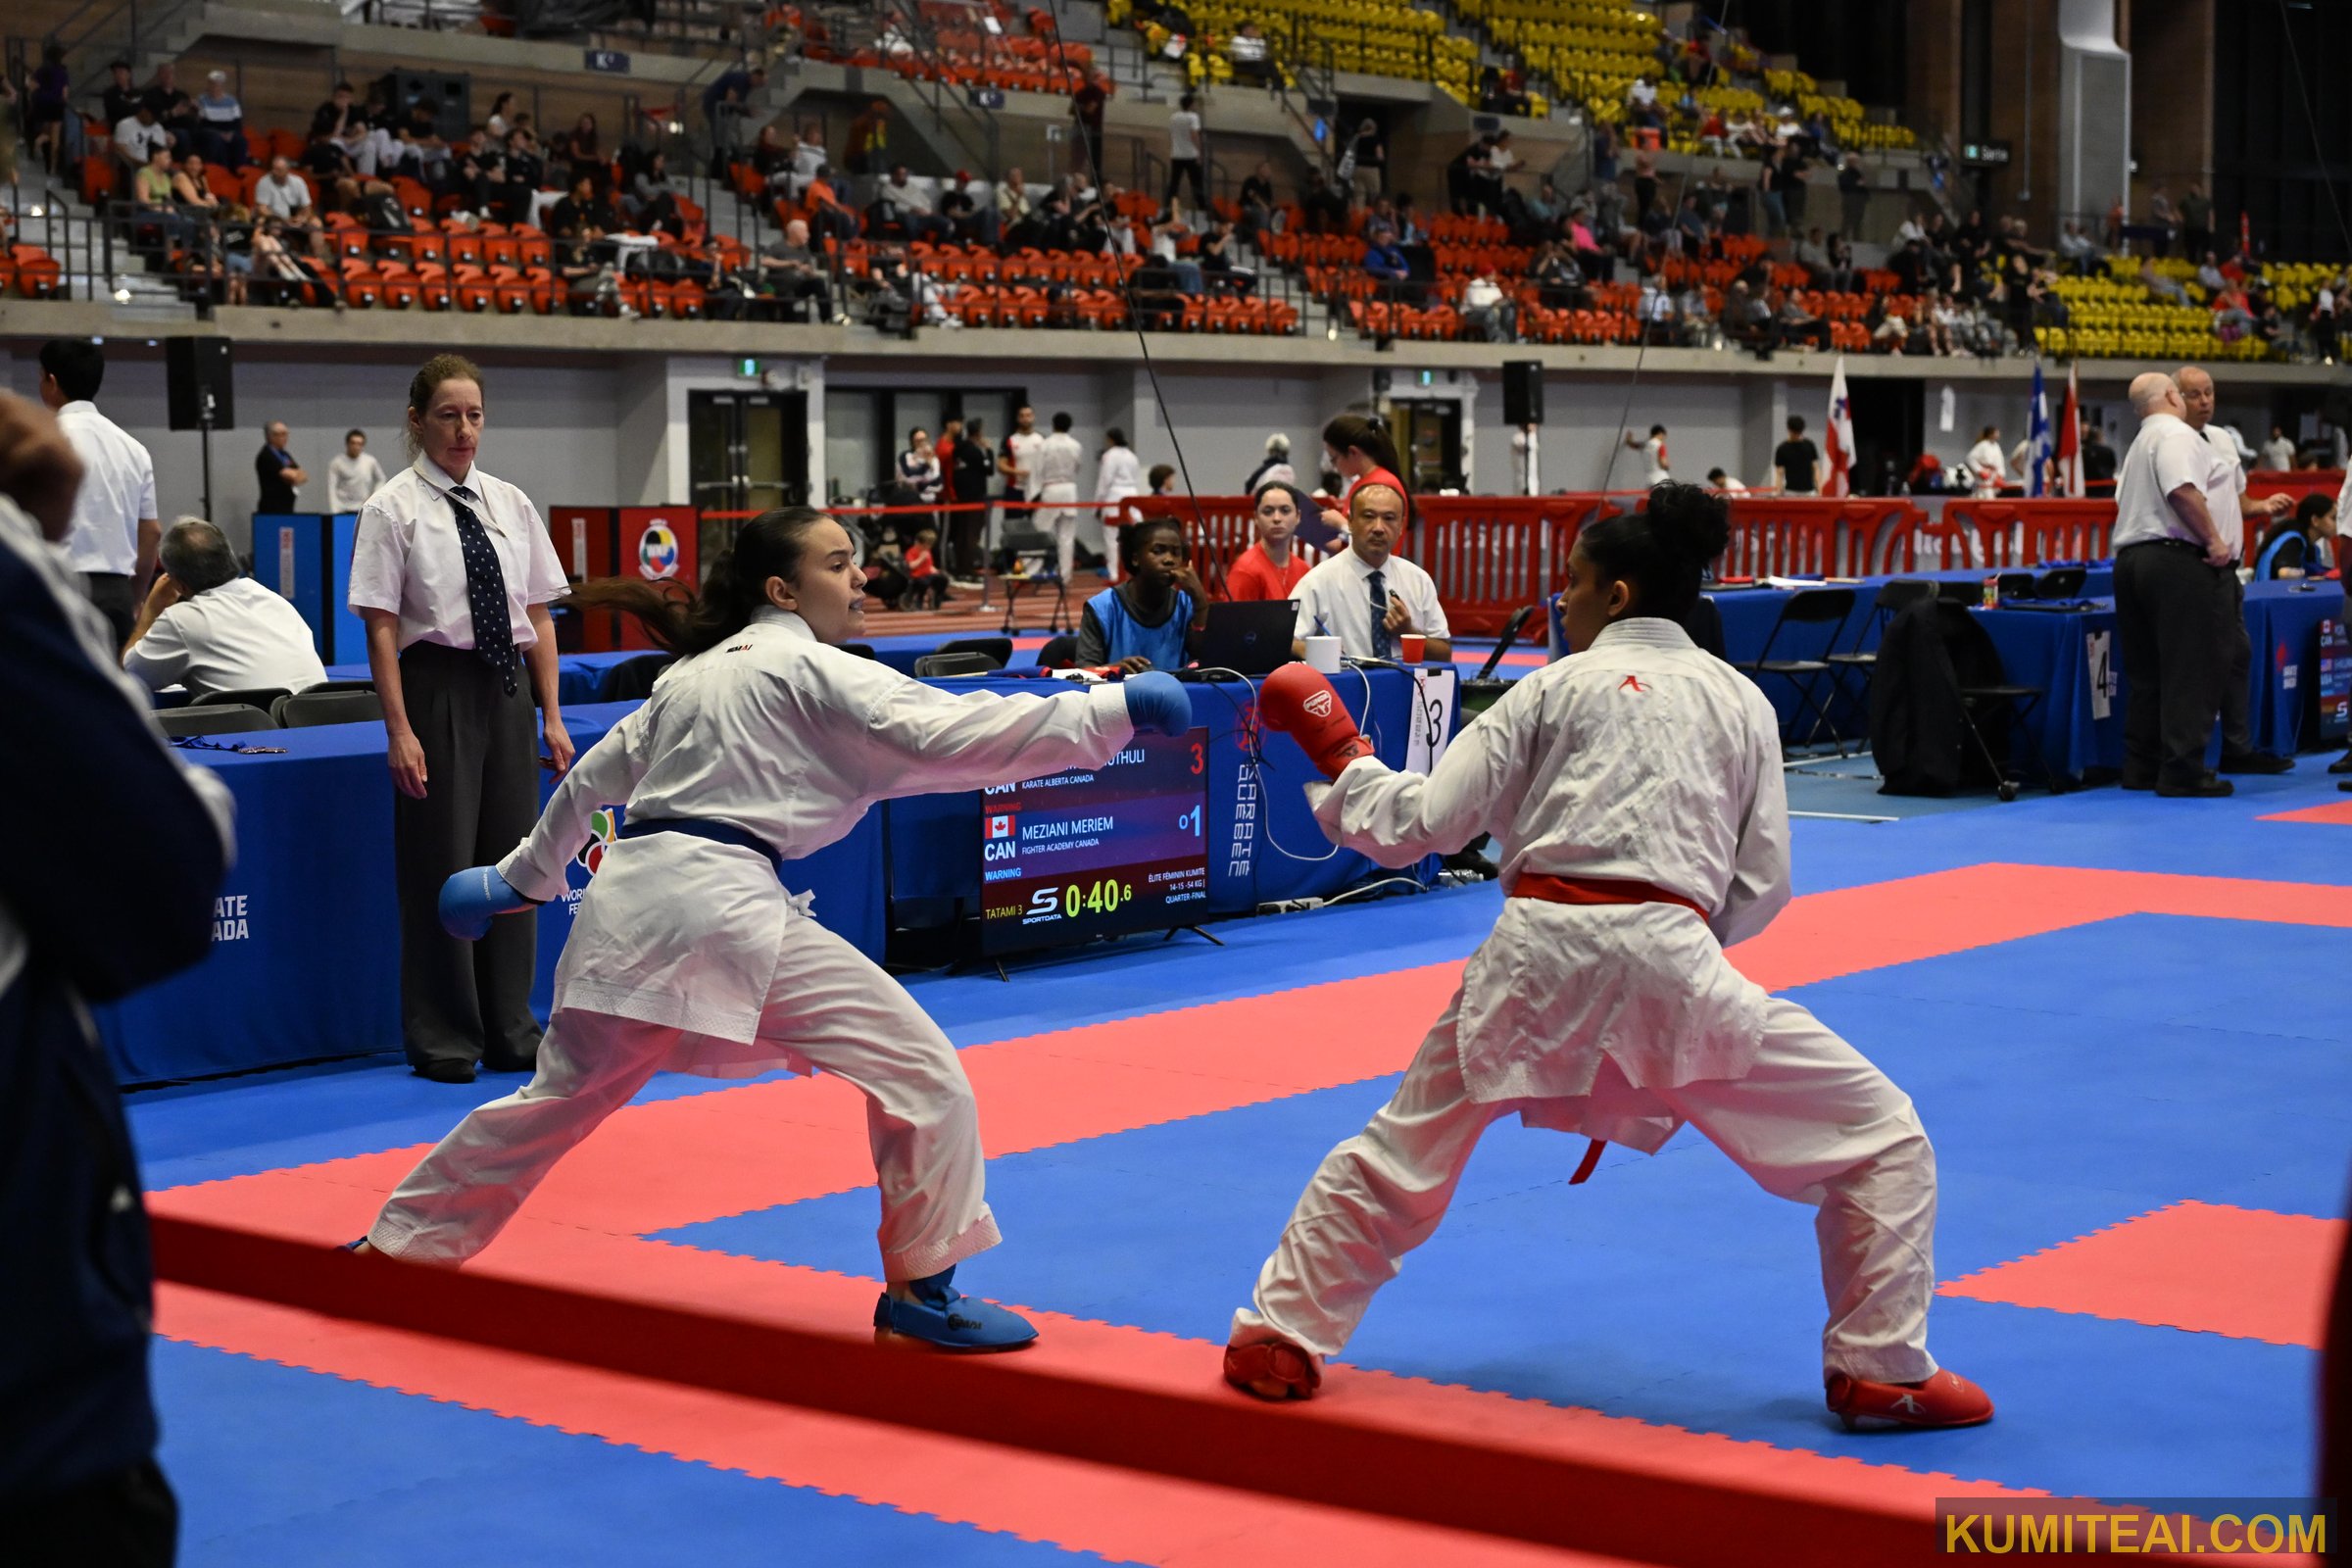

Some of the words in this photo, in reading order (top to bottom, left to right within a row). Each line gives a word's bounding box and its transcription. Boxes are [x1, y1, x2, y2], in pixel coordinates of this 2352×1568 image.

[2097, 651, 2107, 699] 4
[1426, 699, 1443, 748] 3
[1191, 743, 1203, 775] 3
[1022, 779, 1044, 789] KARATE
[1045, 777, 1069, 787] ALBERTA
[1069, 774, 1095, 784] CANADA
[1022, 822, 1068, 841] MEZIANI
[1071, 816, 1113, 835] MERIEM
[985, 841, 1015, 861] CAN
[1022, 845, 1046, 855] FIGHTER
[1046, 841, 1074, 852] ACADEMY
[1075, 838, 1100, 849] CANADA
[985, 867, 1022, 881] WARNING
[1185, 867, 1205, 877] KUMITE
[562, 888, 586, 902] WOR
[1165, 891, 1206, 904] QUARTER-FINAL
[214, 895, 248, 917] ATE
[985, 906, 1015, 919] TATAMI
[1017, 905, 1023, 915] 3
[1022, 913, 1062, 925] SPORTDATA
[212, 918, 249, 942] ADA
